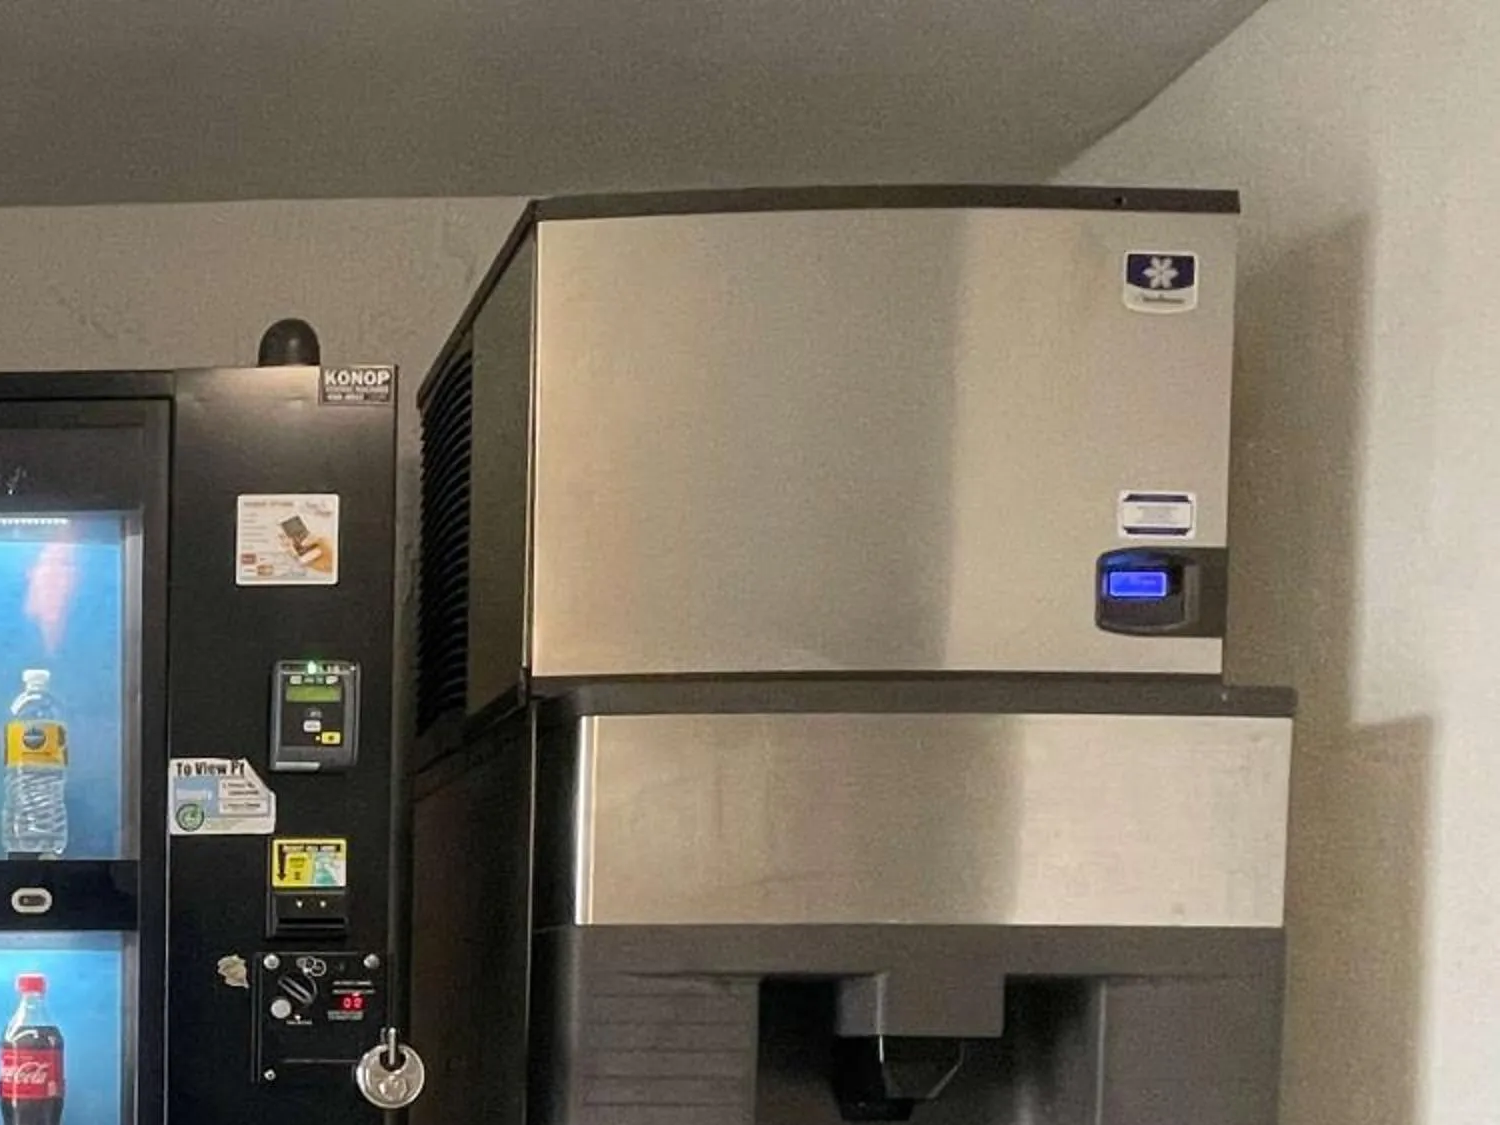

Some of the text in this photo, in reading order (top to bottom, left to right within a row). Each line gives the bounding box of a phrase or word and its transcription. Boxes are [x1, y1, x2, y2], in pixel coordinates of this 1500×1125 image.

[325, 369, 391, 385] KONOP
[177, 761, 193, 776] To
[195, 761, 227, 775] View
